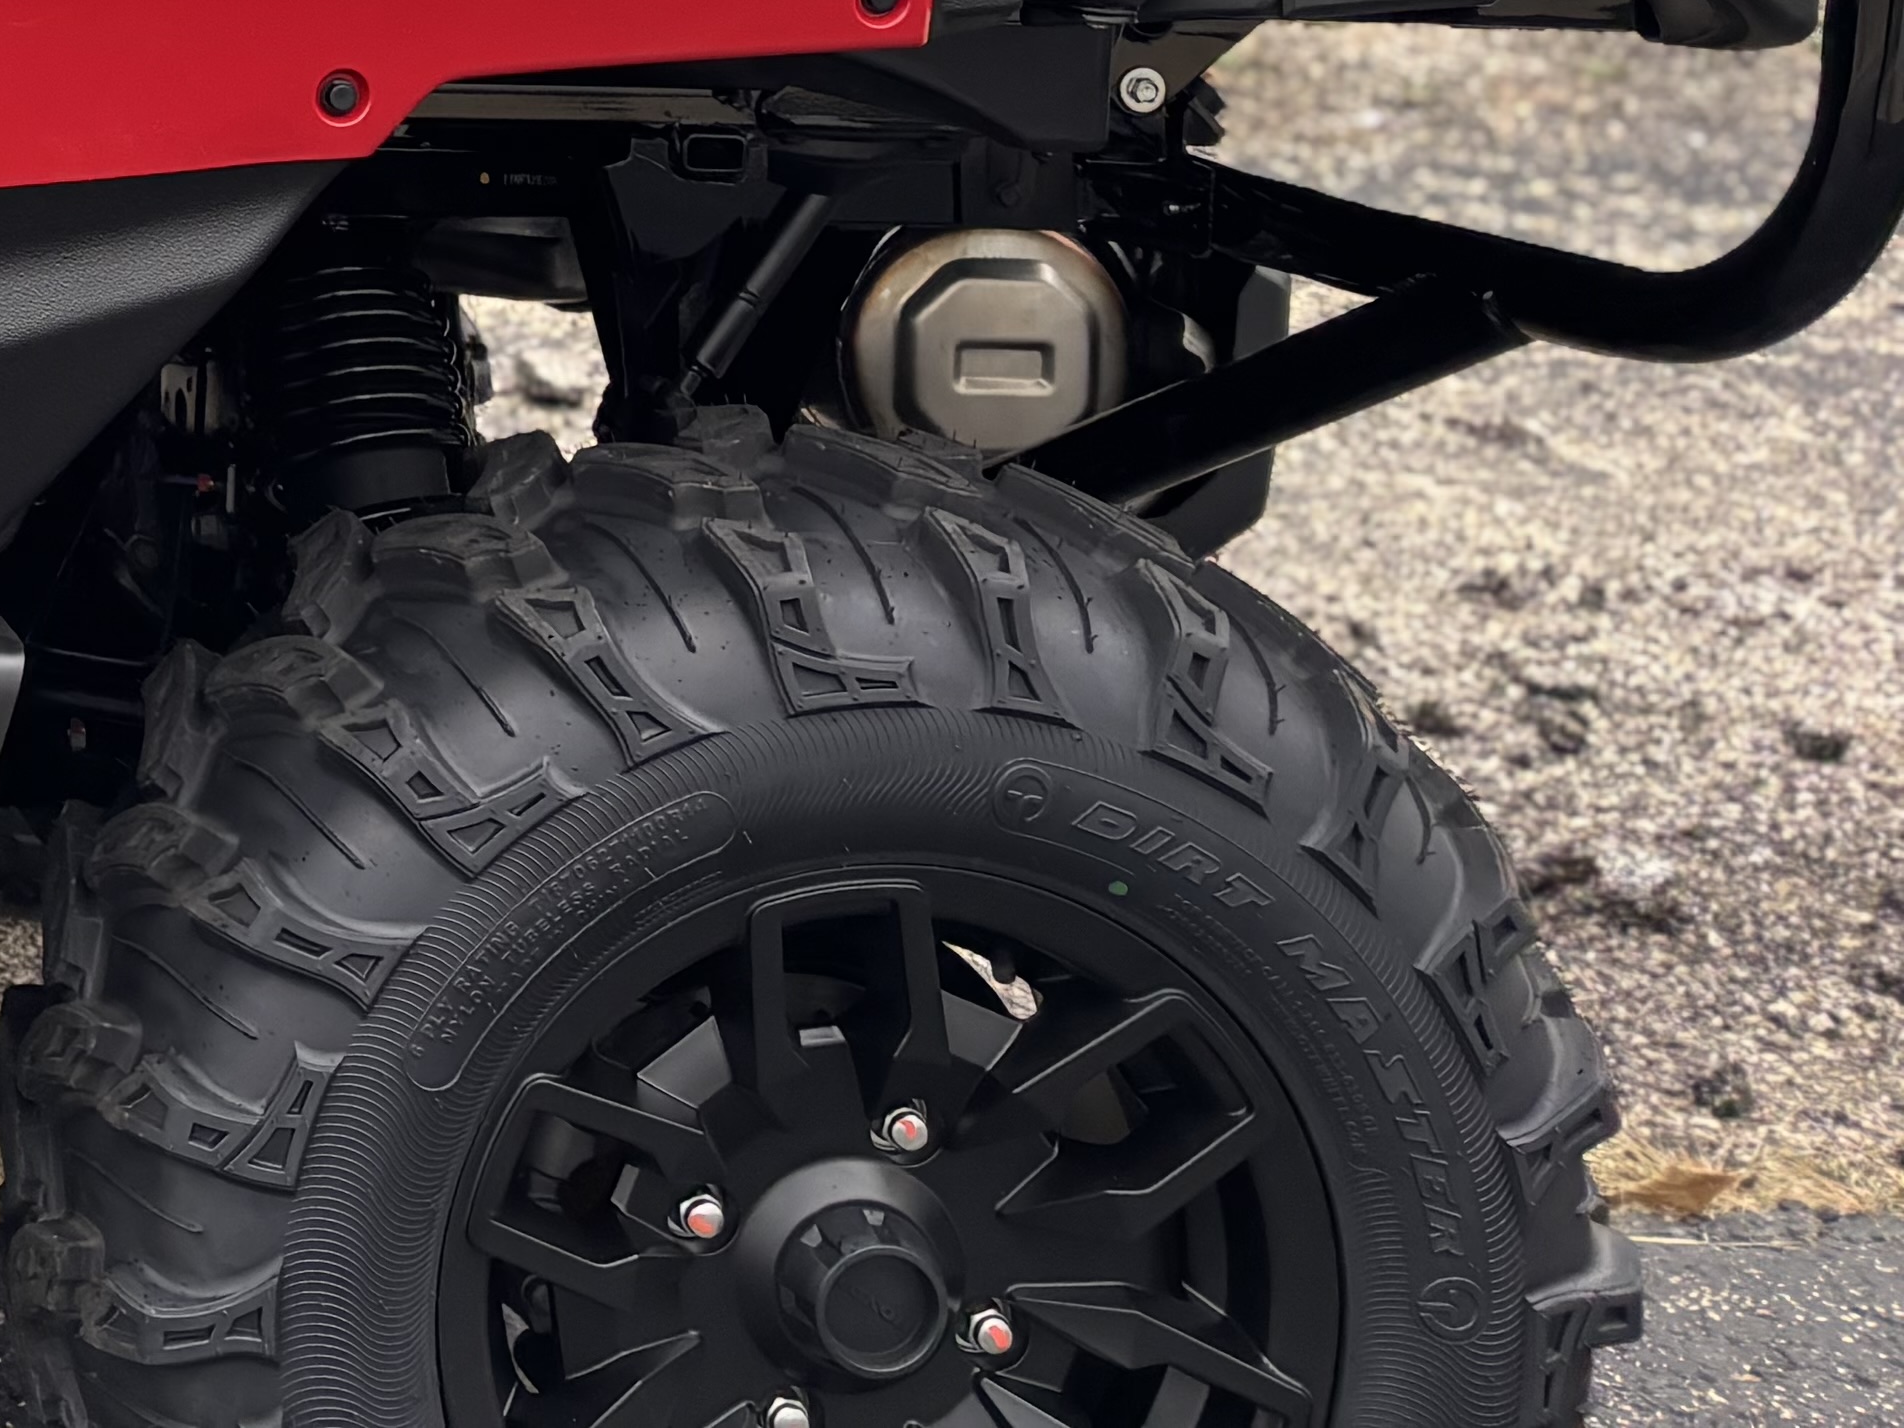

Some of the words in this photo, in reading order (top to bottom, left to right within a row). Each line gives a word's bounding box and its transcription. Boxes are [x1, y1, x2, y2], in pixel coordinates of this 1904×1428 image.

[441, 975, 494, 1042] NYLON
[501, 882, 596, 961] TUBELESS
[452, 920, 519, 992] RATING
[1071, 800, 1276, 908] DIRT
[1276, 933, 1464, 1256] MASTER
